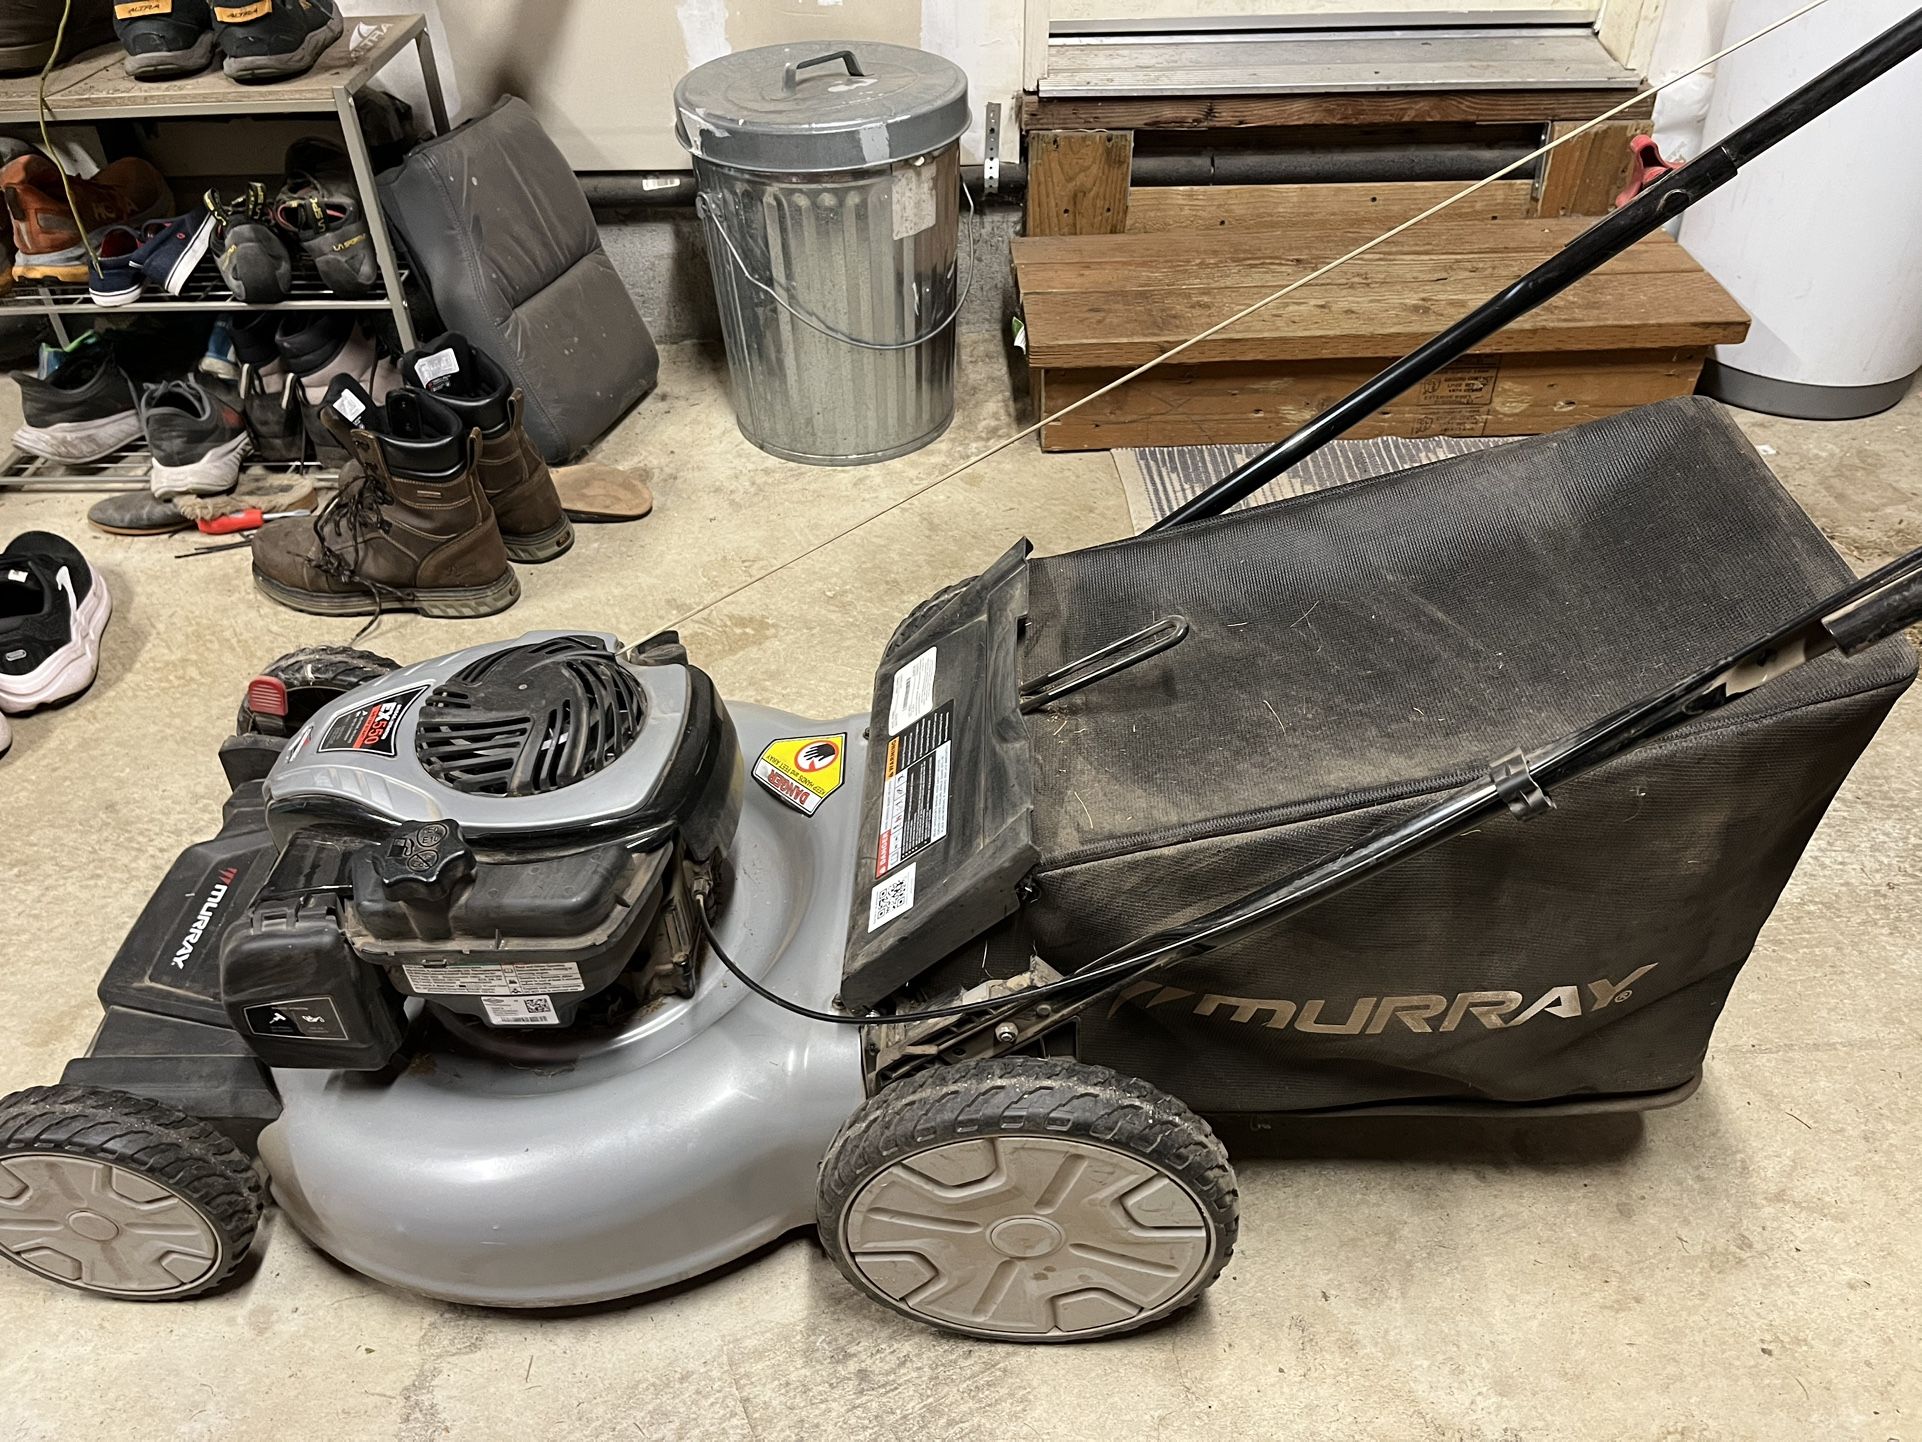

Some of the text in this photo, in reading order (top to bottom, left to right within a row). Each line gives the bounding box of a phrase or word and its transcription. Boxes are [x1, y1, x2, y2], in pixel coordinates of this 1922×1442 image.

[766, 754, 826, 795] KEEP HANDS and FEET AWAY
[889, 739, 898, 772] WARNING
[768, 769, 811, 805] DANGER
[880, 831, 890, 864] DANGER
[172, 884, 228, 969] MURRAY
[1194, 962, 1659, 1034] MURRAY
